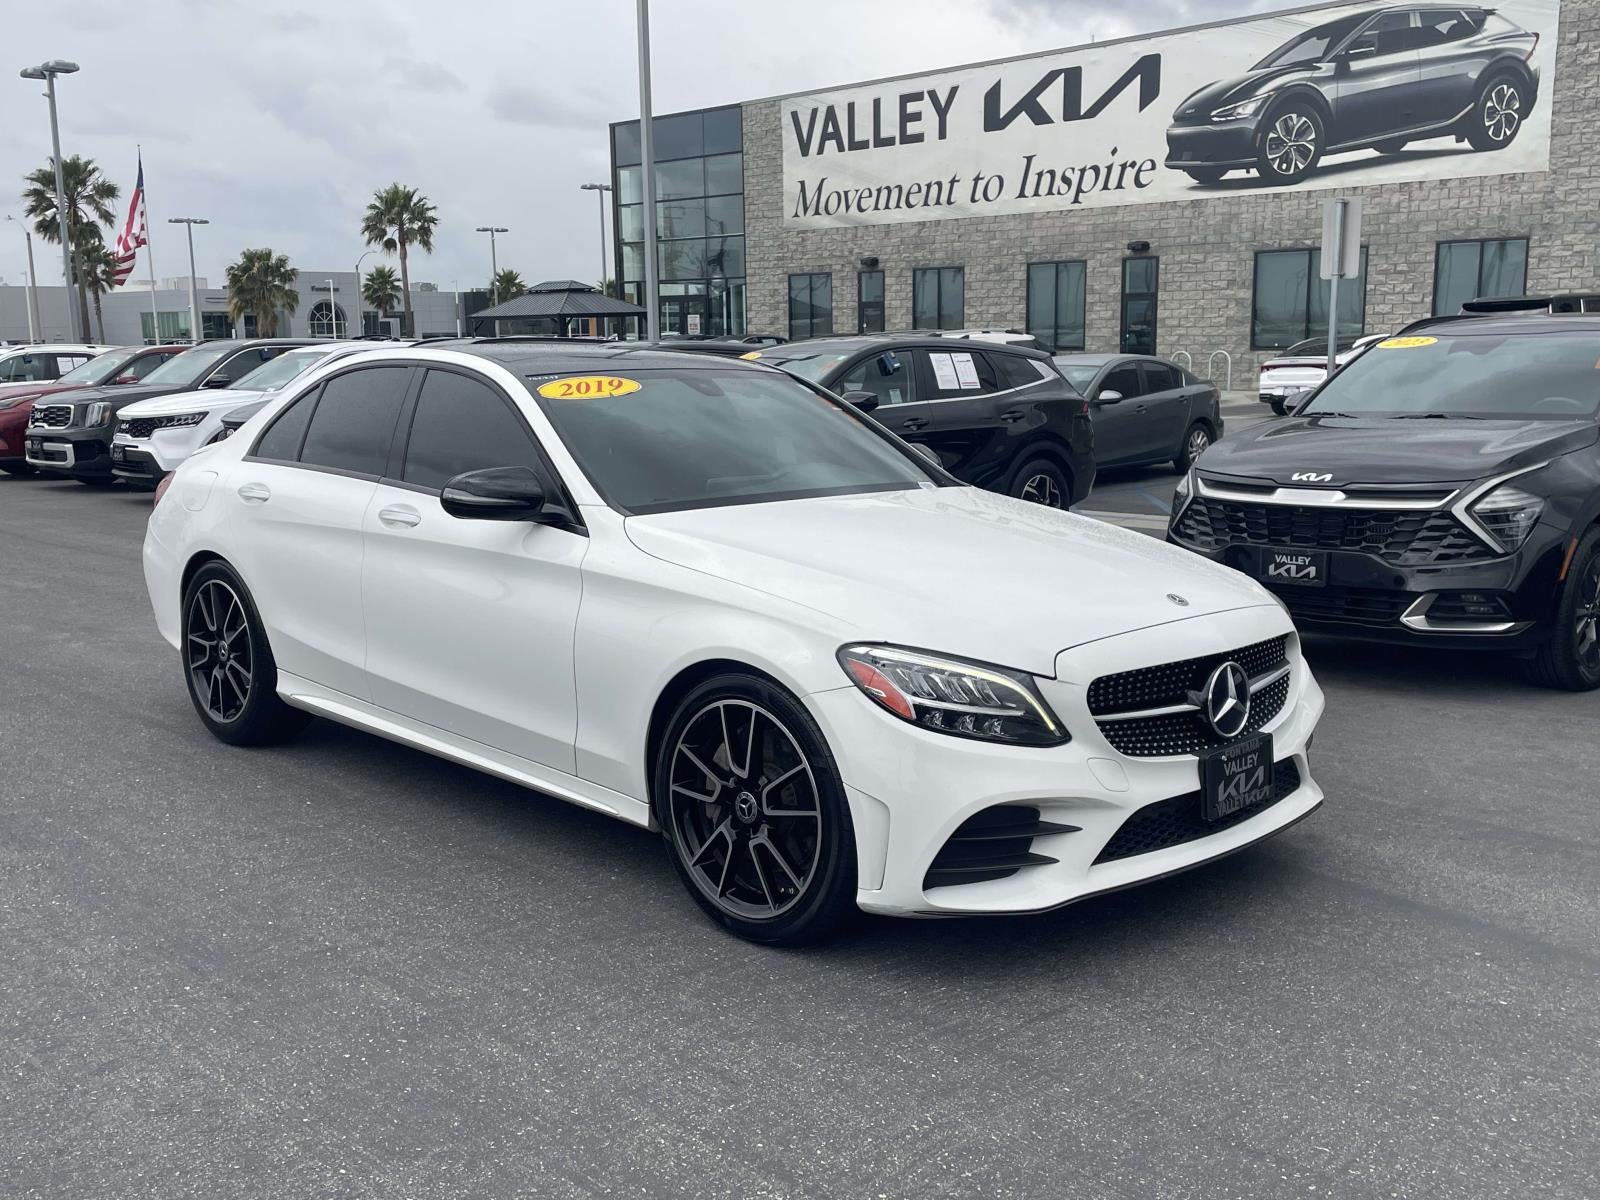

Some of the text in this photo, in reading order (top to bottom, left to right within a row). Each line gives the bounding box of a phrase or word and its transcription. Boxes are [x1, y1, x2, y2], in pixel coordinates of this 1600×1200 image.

[790, 53, 1161, 157] VALLEY KIA
[792, 147, 1157, 218] Movement to Inspire
[559, 379, 623, 397] 2019
[1291, 472, 1333, 482] KIA
[1275, 554, 1311, 565] VALLEY
[1268, 563, 1316, 578] KIA
[1224, 752, 1259, 776] VALLEY
[1218, 765, 1264, 802] KIA
